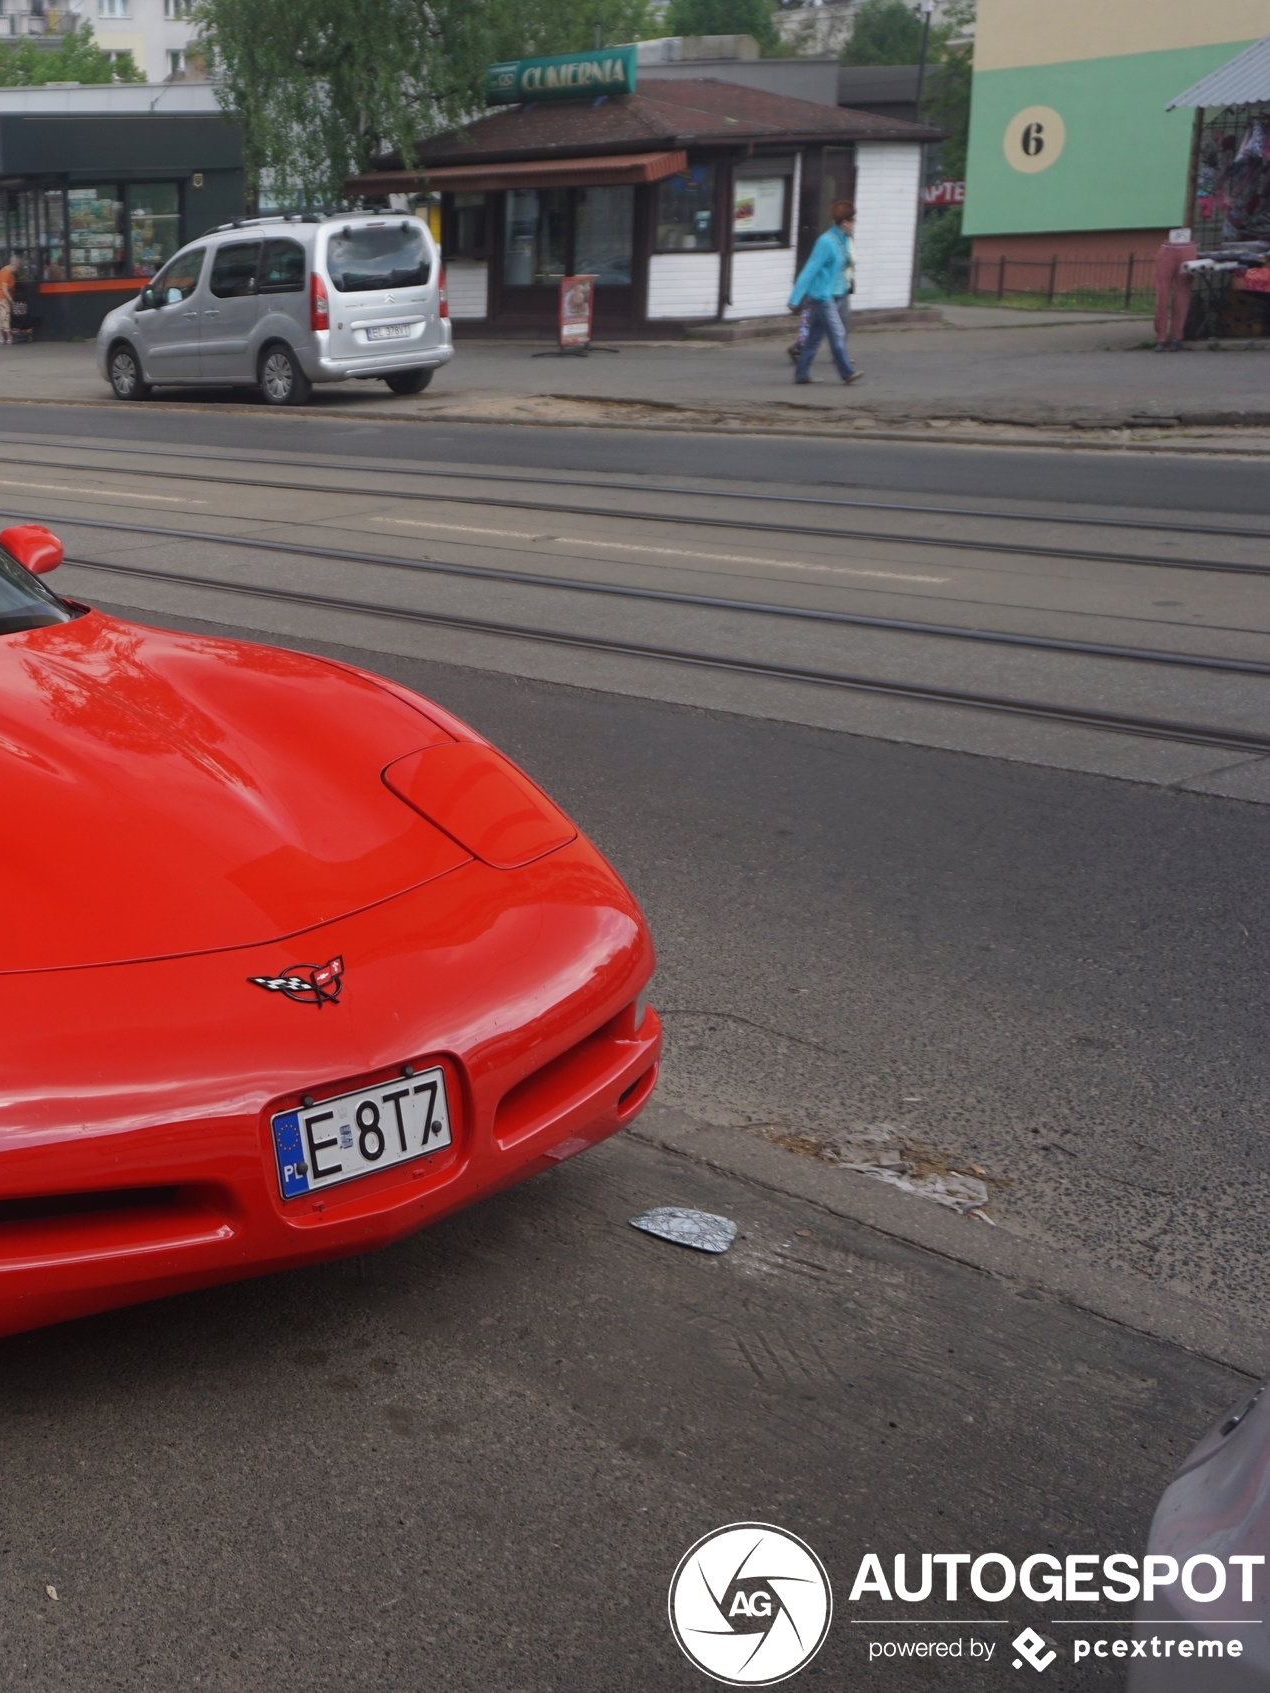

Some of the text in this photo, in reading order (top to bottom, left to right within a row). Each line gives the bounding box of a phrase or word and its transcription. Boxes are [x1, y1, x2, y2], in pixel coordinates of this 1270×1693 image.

[521, 58, 626, 90] CUKIERNIA
[1022, 122, 1045, 156] 6
[372, 327, 384, 338] EL
